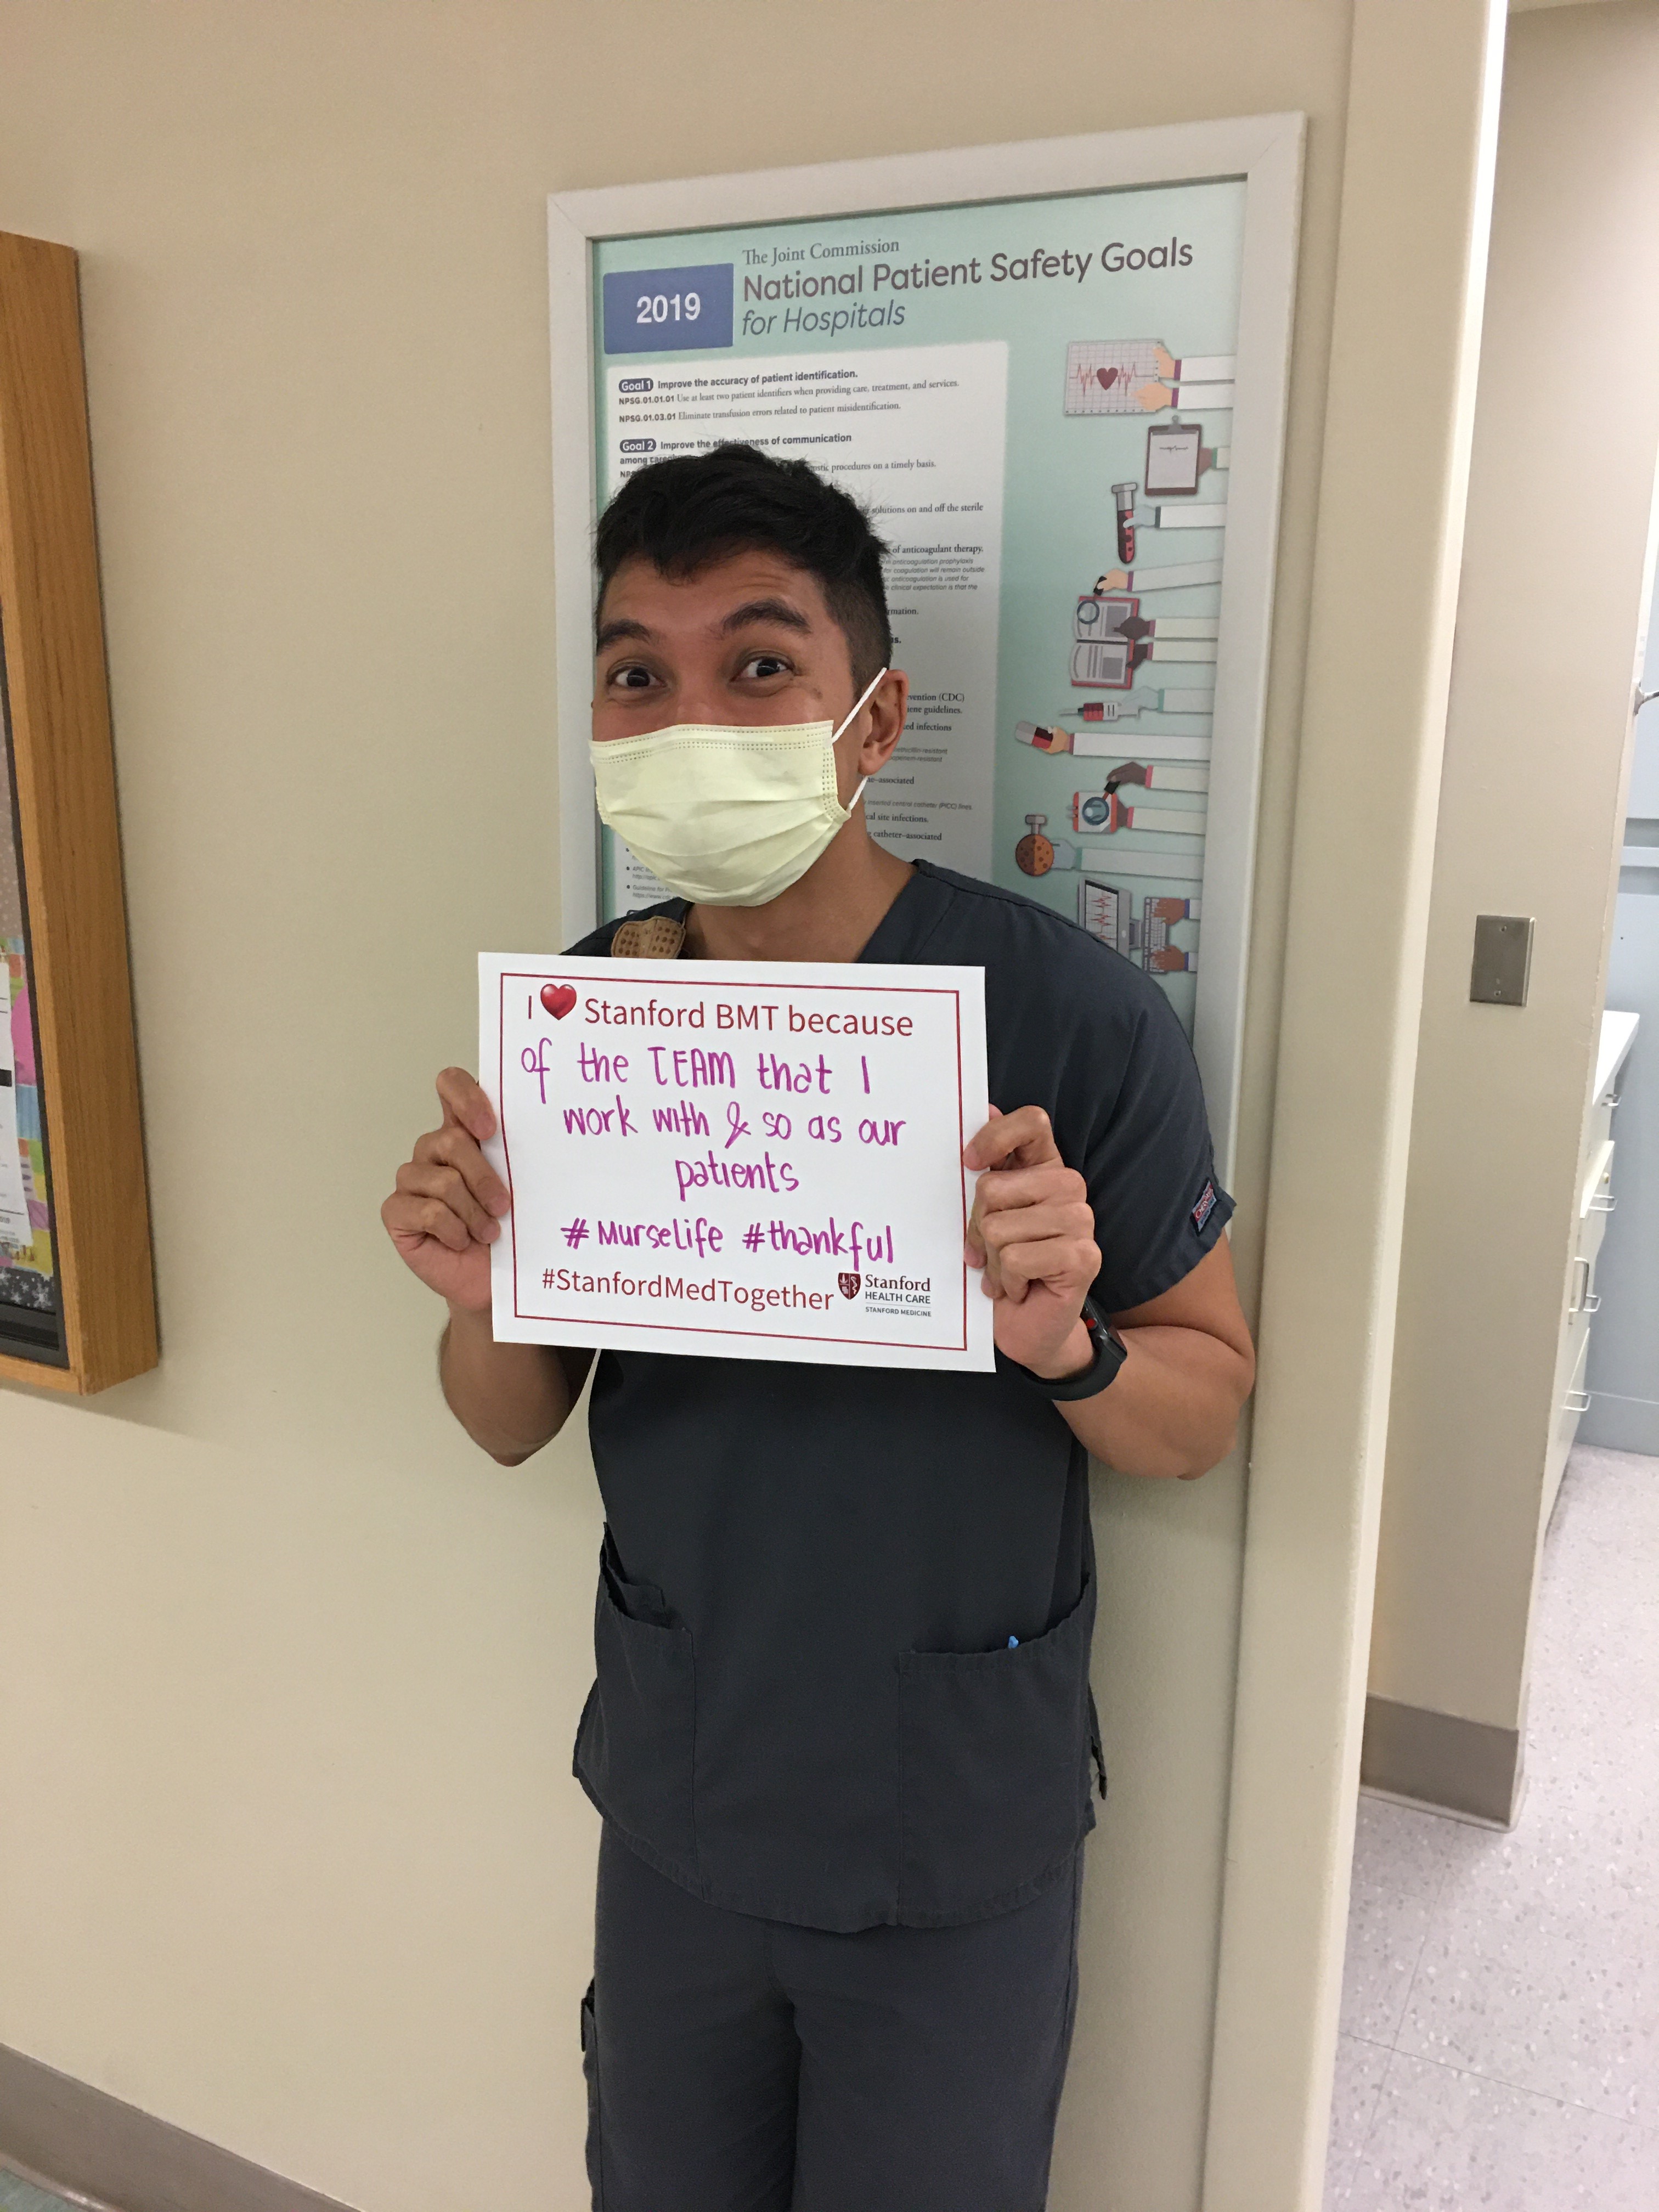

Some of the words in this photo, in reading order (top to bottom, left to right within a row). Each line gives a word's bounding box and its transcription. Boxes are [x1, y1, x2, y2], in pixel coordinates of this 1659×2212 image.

[743, 248, 768, 265] The
[771, 246, 805, 267] Joint
[810, 238, 900, 260] Commission
[744, 264, 863, 302] National
[873, 257, 982, 292] Patient
[990, 248, 1093, 284] Safety
[1101, 236, 1193, 272] Goals
[636, 292, 701, 323] 2019
[742, 309, 777, 336] for
[783, 299, 906, 337] Hospitals
[622, 380, 644, 391] Goal
[646, 380, 651, 390] 1
[658, 380, 692, 390] Improve
[695, 378, 708, 387] the
[710, 377, 748, 386] accuracy
[751, 375, 760, 383] of
[762, 373, 793, 385] patient
[795, 369, 857, 381] identification.
[619, 395, 674, 405] NPSG.01.01.01
[678, 393, 689, 402] Use
[699, 392, 714, 401] least
[731, 391, 755, 402] patient
[757, 387, 792, 397] identifiers
[794, 387, 813, 395] when
[815, 385, 851, 397] providing
[872, 383, 910, 391] treatment,
[912, 380, 927, 389] and
[929, 379, 960, 388] services.
[619, 413, 676, 422] NPSG.01.03.01
[679, 411, 710, 420] Eliminate
[713, 409, 750, 419] transfusion
[774, 405, 798, 415] related
[809, 406, 835, 416] patient
[837, 402, 901, 413] misidentification.
[623, 441, 645, 451] Goal
[647, 441, 653, 450] 2
[661, 441, 695, 450] Improve
[697, 439, 711, 448] the
[771, 436, 780, 444] of
[782, 433, 852, 444] communication
[620, 457, 647, 466] among
[832, 461, 871, 473] procedures
[891, 460, 915, 470] timely
[916, 459, 936, 468] basis.
[872, 505, 905, 514] solutions
[919, 504, 932, 513] and
[934, 503, 946, 512] off
[947, 503, 959, 512] the
[961, 503, 984, 511] sterile
[893, 545, 901, 553] of
[902, 544, 952, 555] anticoagulant
[954, 544, 984, 555] therapy.
[939, 693, 965, 703] (CDC)
[924, 704, 963, 715] guidelines.
[916, 722, 952, 731] infections
[892, 813, 929, 822] infections.
[527, 995, 532, 1020] I
[584, 997, 706, 1030] Stanford
[716, 1004, 779, 1032] BMT
[788, 1010, 913, 1036] because
[521, 1037, 552, 1104] of
[577, 1042, 629, 1086] the
[647, 1046, 735, 1089] TEAM
[757, 1052, 833, 1095] that
[563, 1094, 639, 1137] work
[653, 1099, 710, 1137] with
[724, 1101, 752, 1149] &
[763, 1111, 792, 1141] so
[808, 1116, 843, 1144] as
[859, 1118, 907, 1148] our
[675, 1150, 800, 1202] patients
[741, 1216, 894, 1272] #thankful
[541, 1267, 835, 1312] #StanfordMedTogether
[865, 1274, 931, 1292] Stanford
[865, 1291, 902, 1302] HEALTH
[905, 1294, 930, 1304] CARE
[865, 1306, 899, 1315] STANFORD
[901, 1309, 932, 1317] MEDICINE
